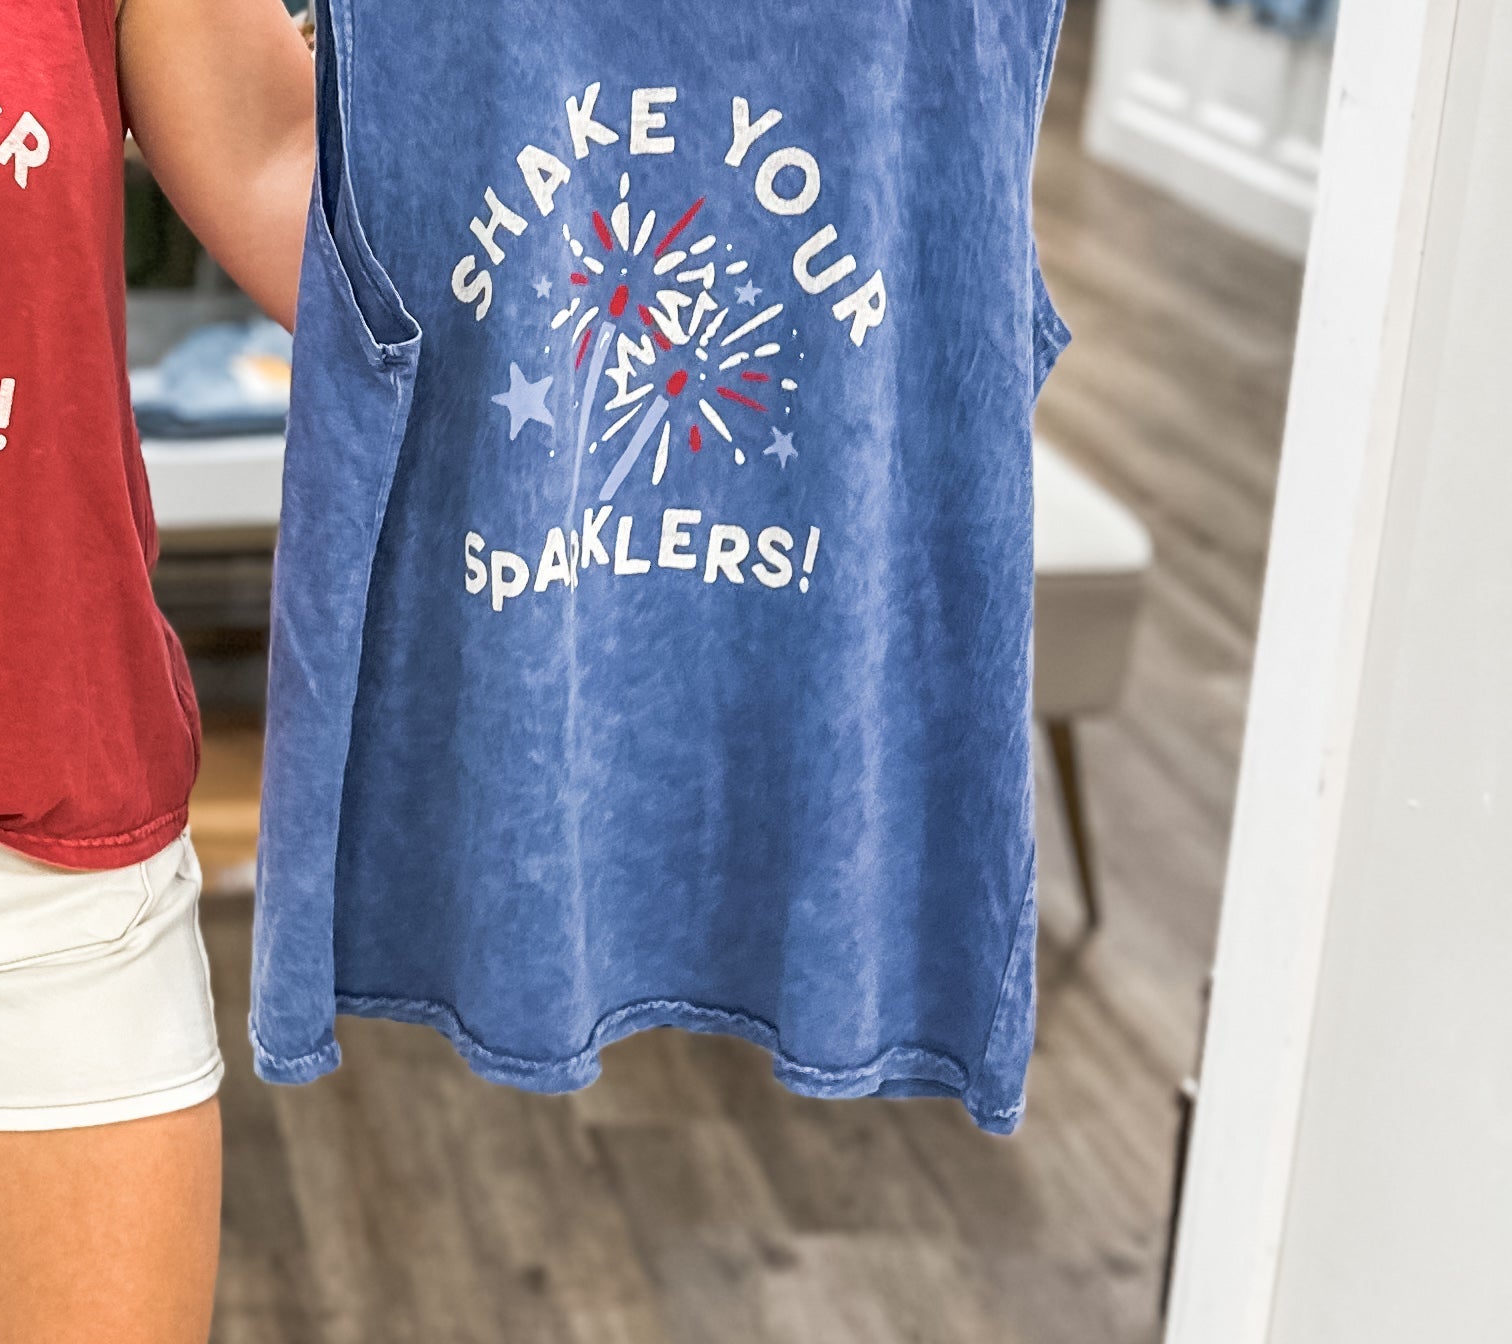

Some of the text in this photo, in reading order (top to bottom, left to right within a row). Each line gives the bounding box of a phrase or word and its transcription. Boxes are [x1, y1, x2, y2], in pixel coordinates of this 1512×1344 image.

[450, 81, 888, 348] SHAKE YOUR
[464, 504, 821, 613] SPARKLERS!
